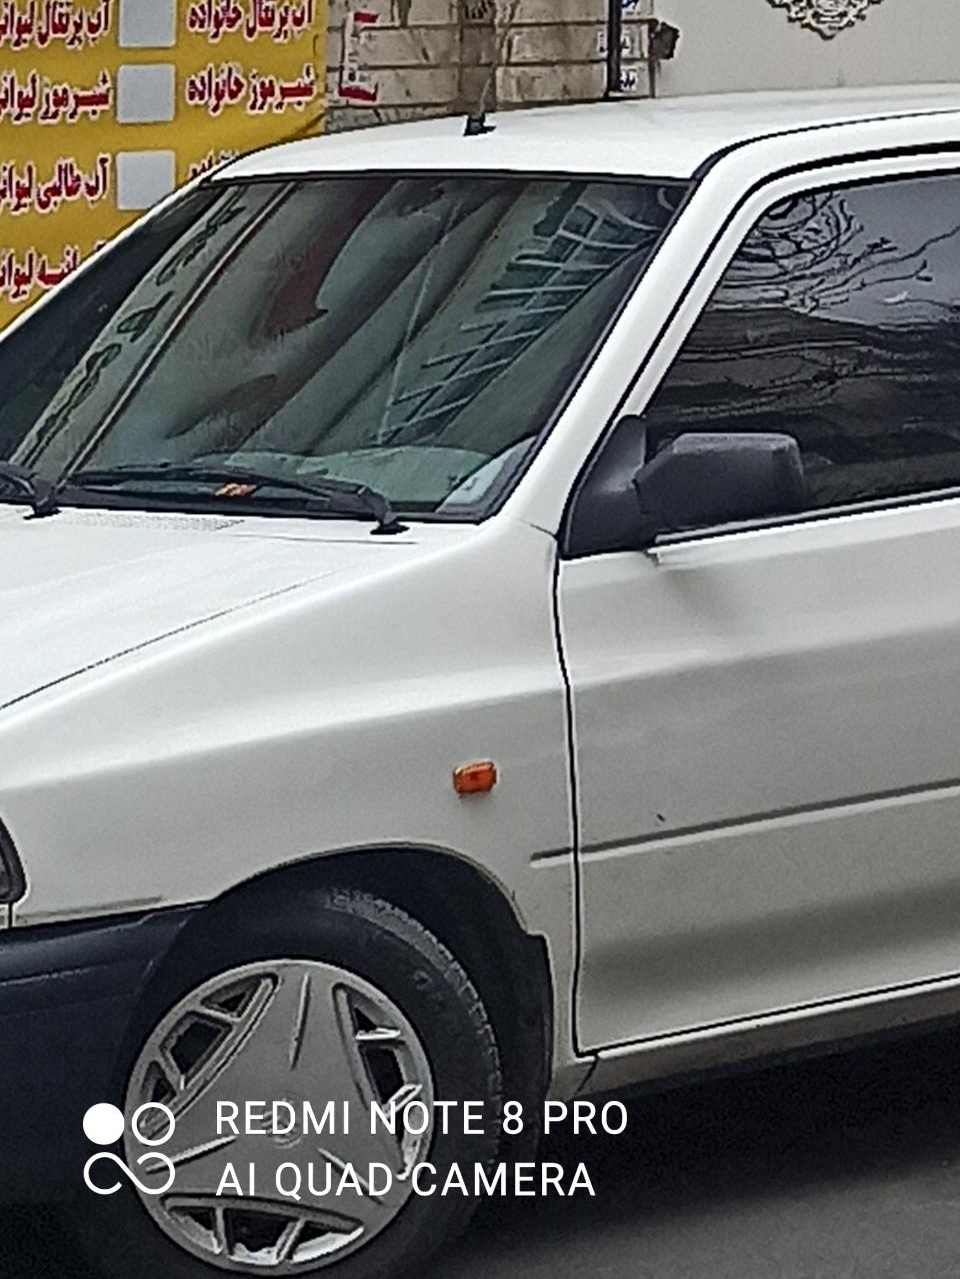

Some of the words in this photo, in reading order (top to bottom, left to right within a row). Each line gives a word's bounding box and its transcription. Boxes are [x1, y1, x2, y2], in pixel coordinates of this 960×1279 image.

[186, 63, 245, 117] خانواده
[36, 157, 83, 215] طالبی
[84, 152, 111, 207] آب
